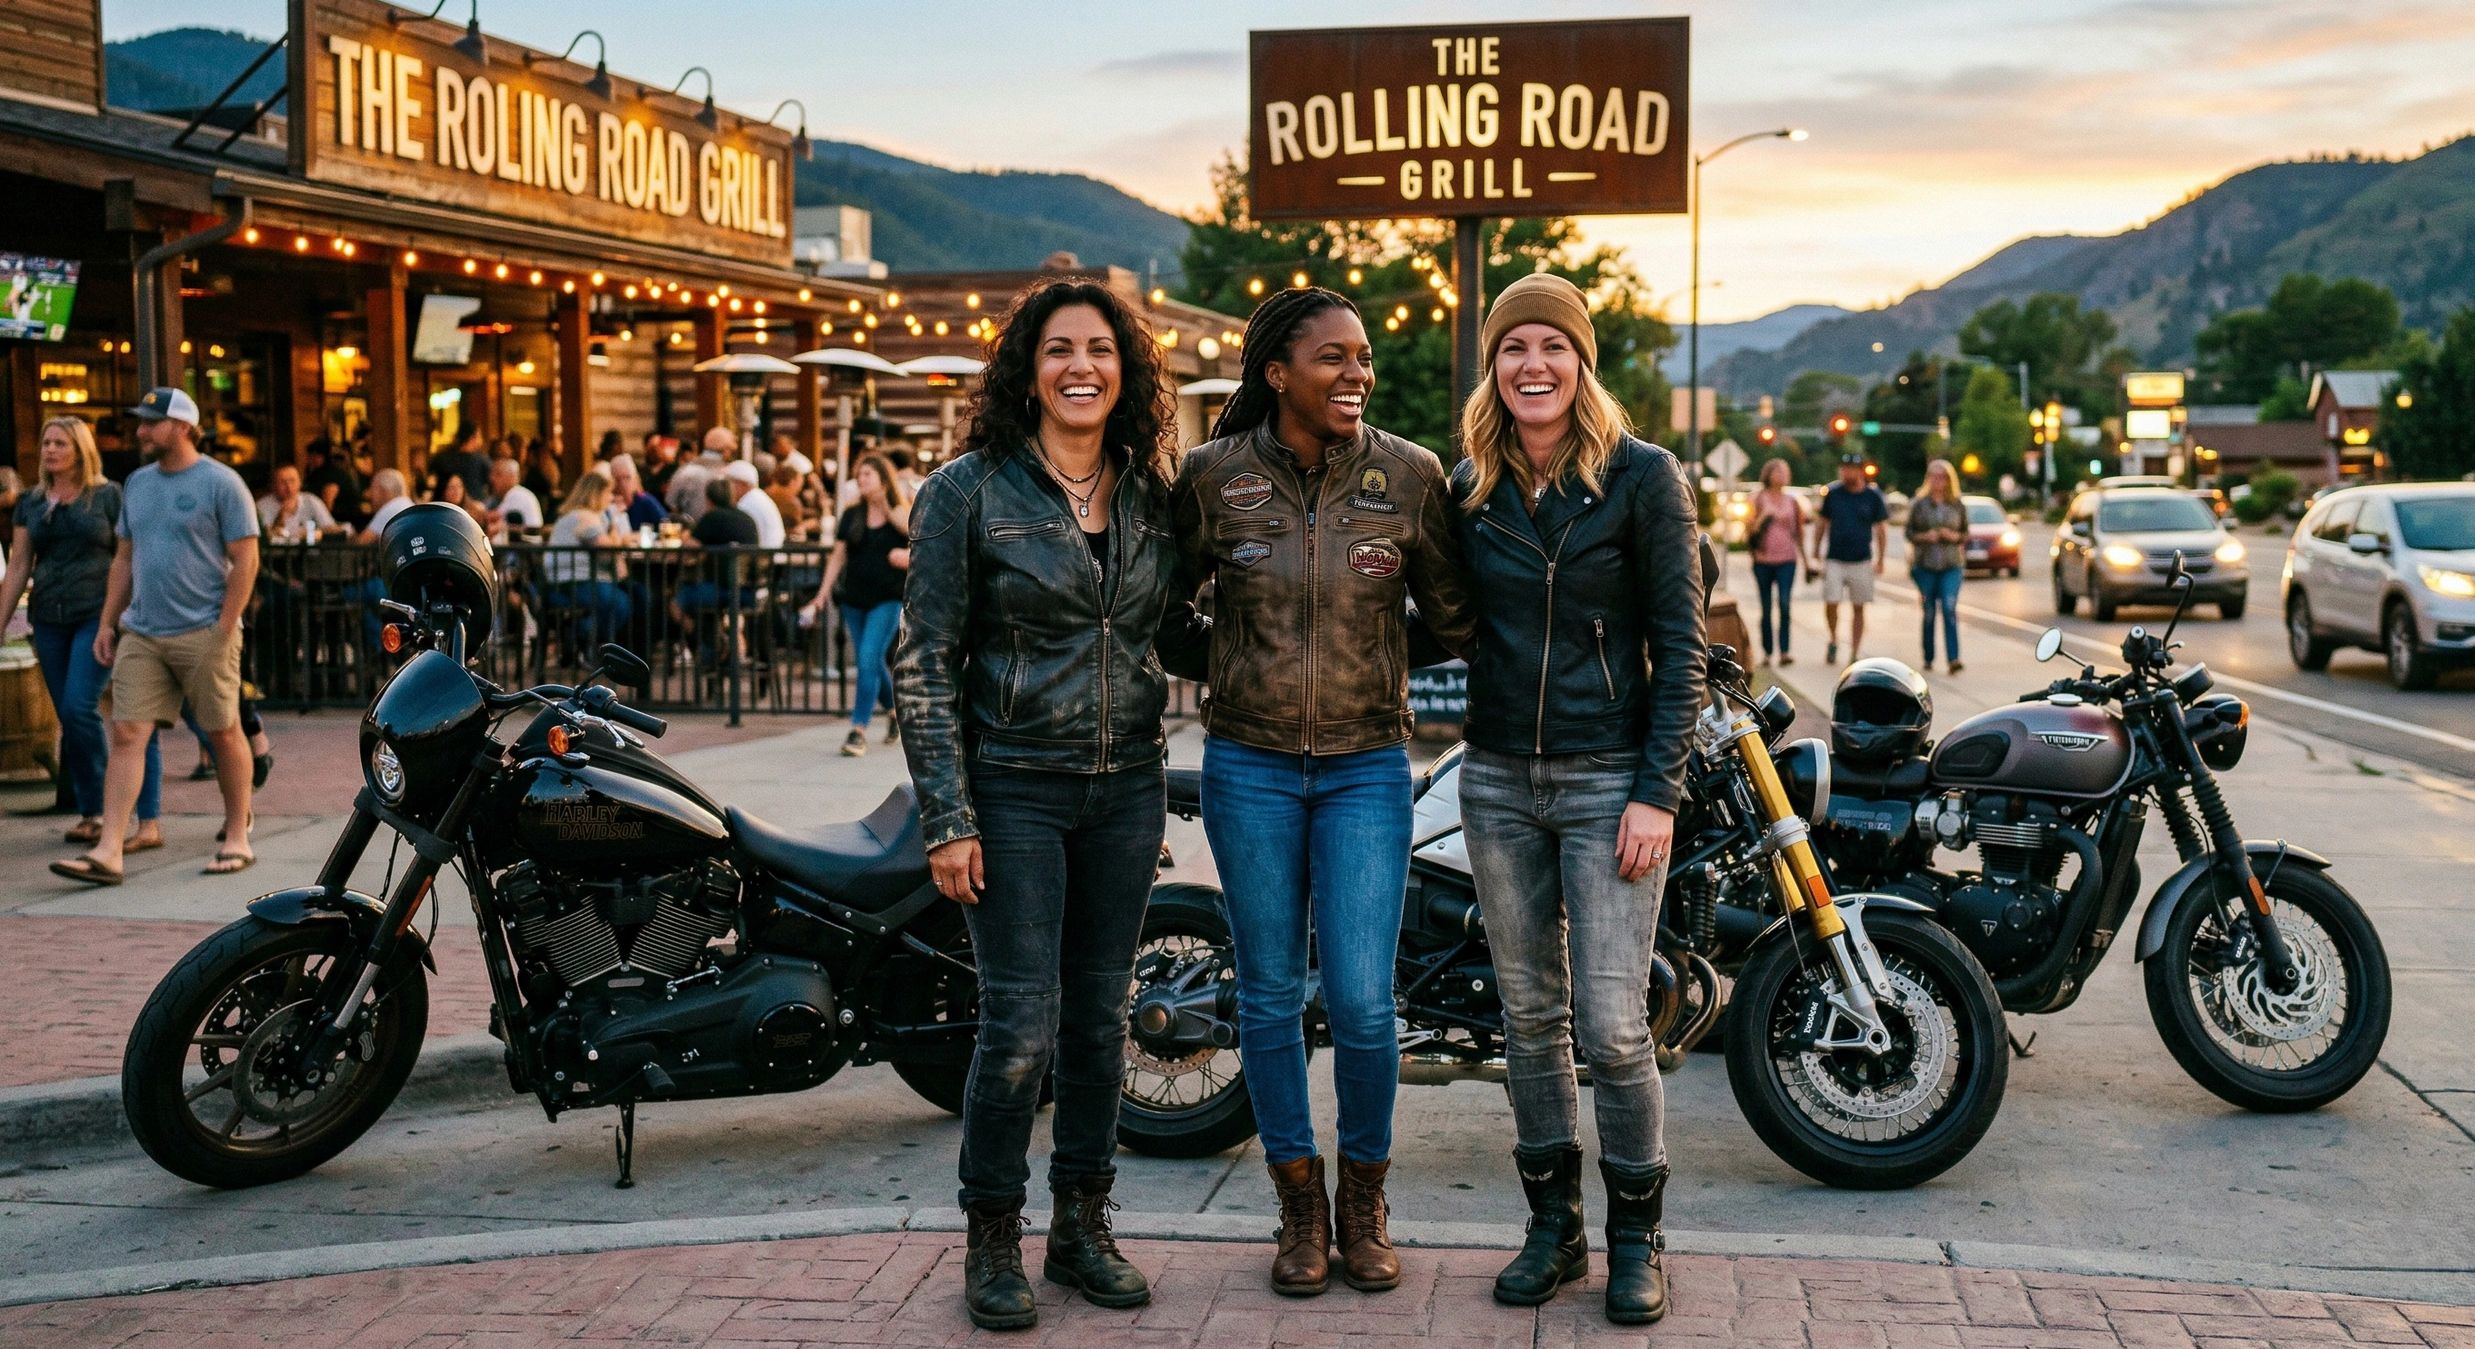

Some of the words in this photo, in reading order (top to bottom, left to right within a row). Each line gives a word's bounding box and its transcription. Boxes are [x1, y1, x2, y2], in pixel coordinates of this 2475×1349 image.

[1431, 37, 1500, 76] THE
[329, 35, 424, 160] THE
[436, 66, 589, 195] ROLING
[598, 111, 690, 217] ROAD
[700, 141, 786, 238] GRILL
[1265, 82, 1500, 165] ROLLING
[1520, 82, 1671, 156] ROAD
[1400, 157, 1533, 200] GRILL
